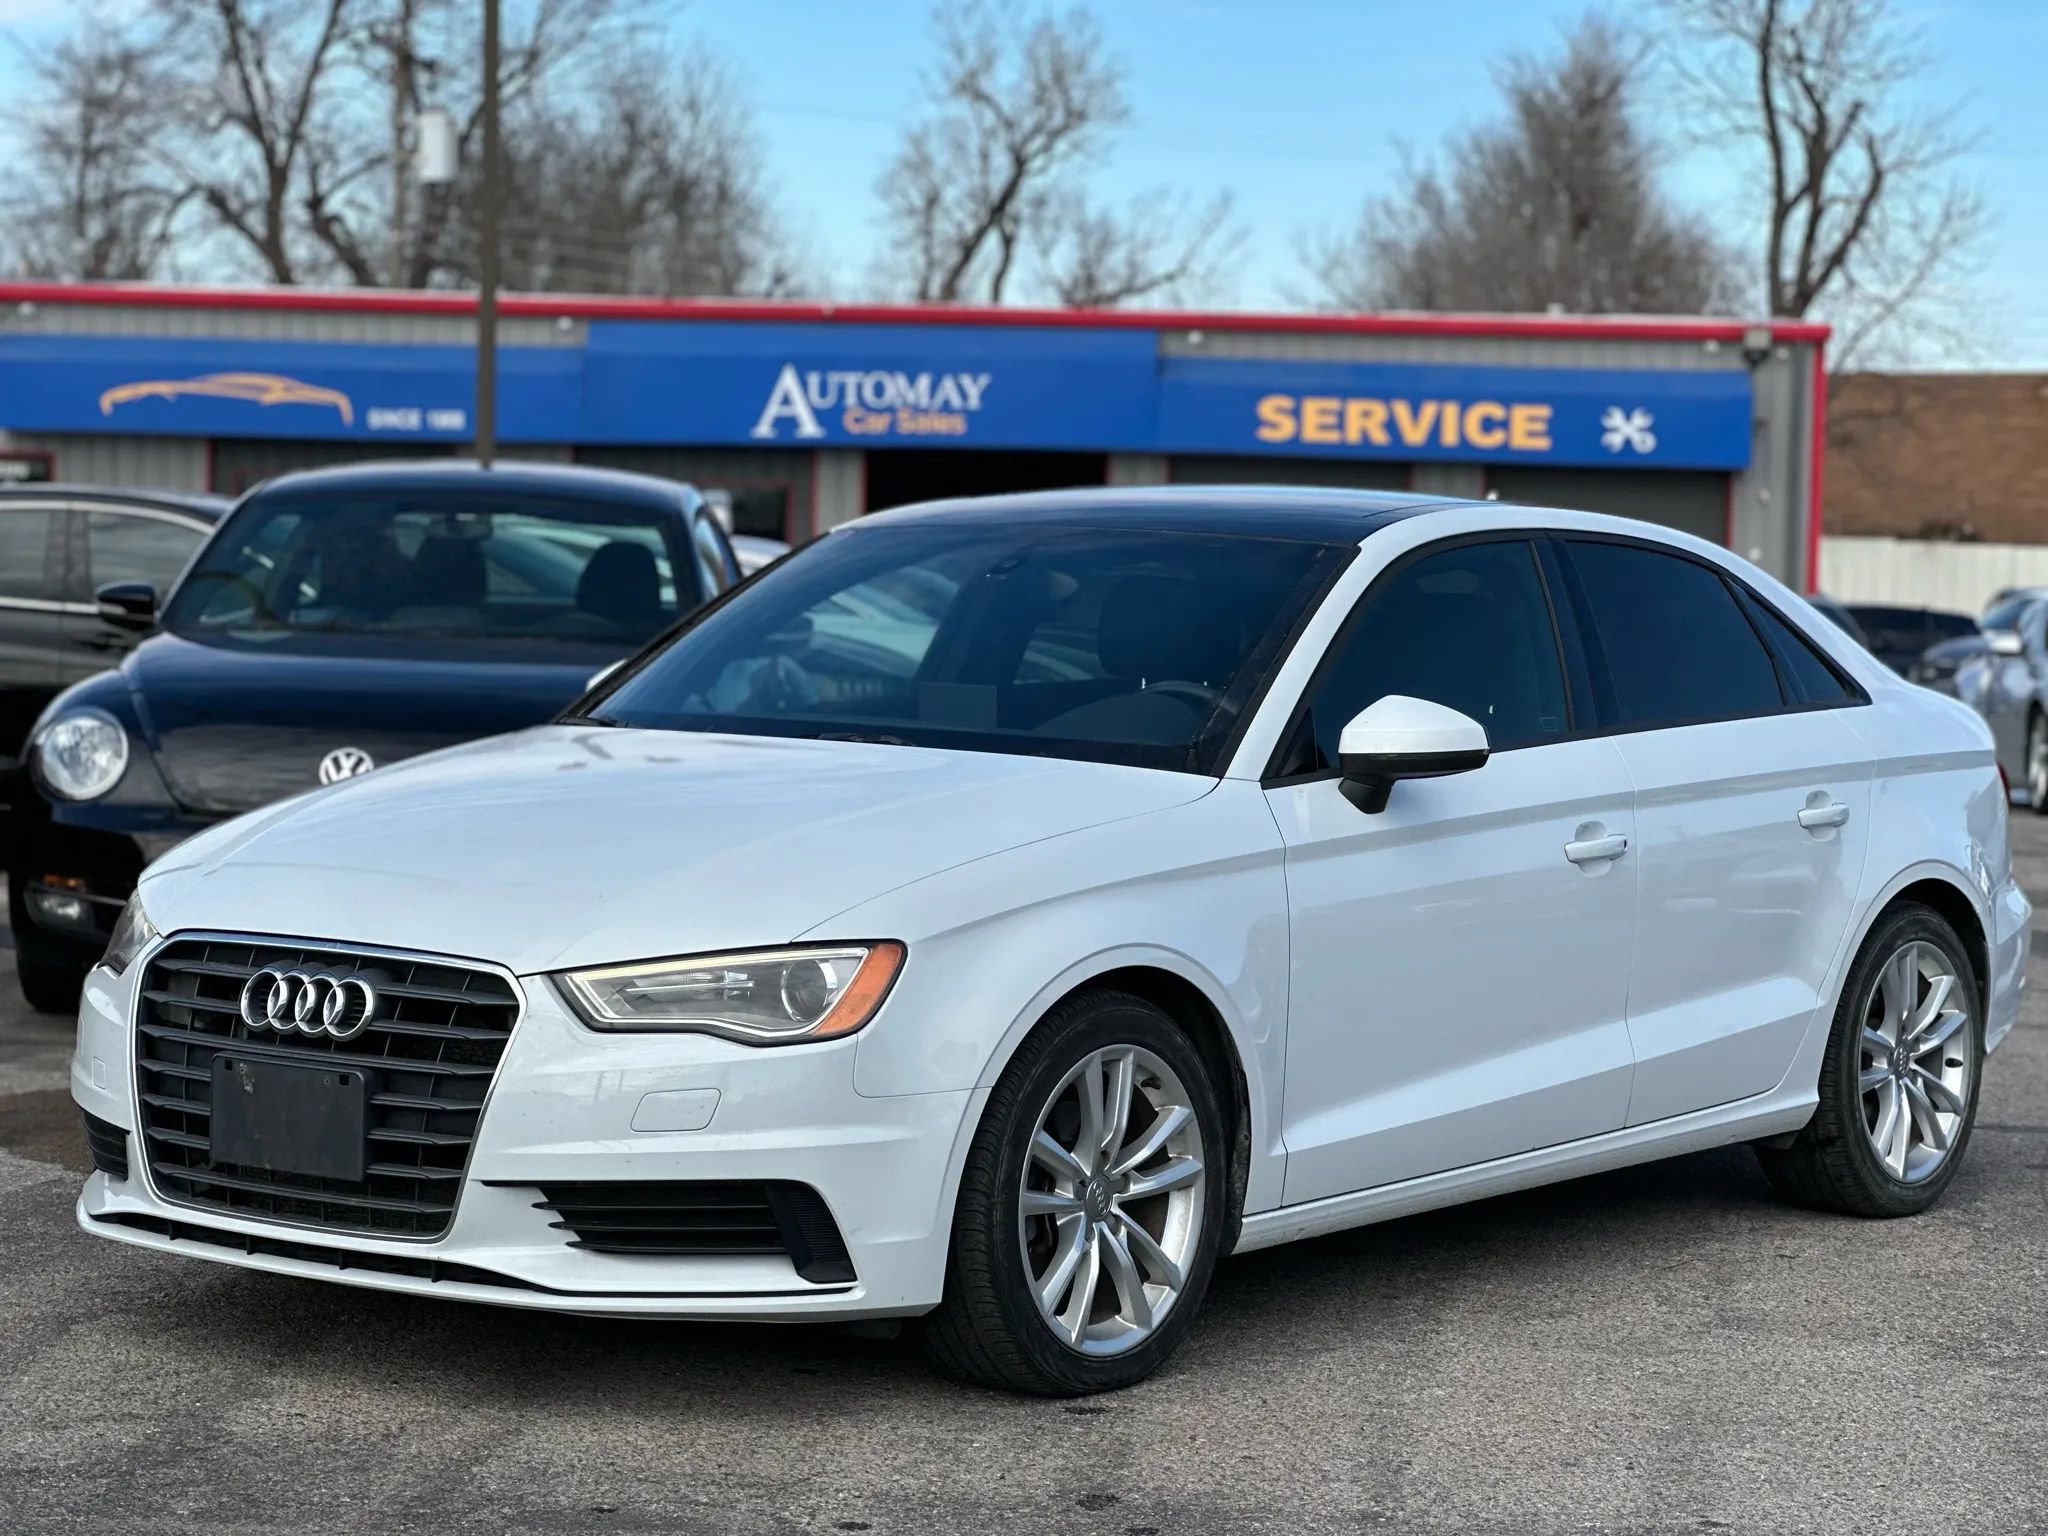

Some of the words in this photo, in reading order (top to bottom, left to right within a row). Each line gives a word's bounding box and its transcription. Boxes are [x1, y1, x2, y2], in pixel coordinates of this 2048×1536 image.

[751, 362, 993, 439] AUTOMAY
[843, 406, 891, 435] Car
[896, 406, 967, 436] Sales
[1256, 394, 1553, 451] SERVICE
